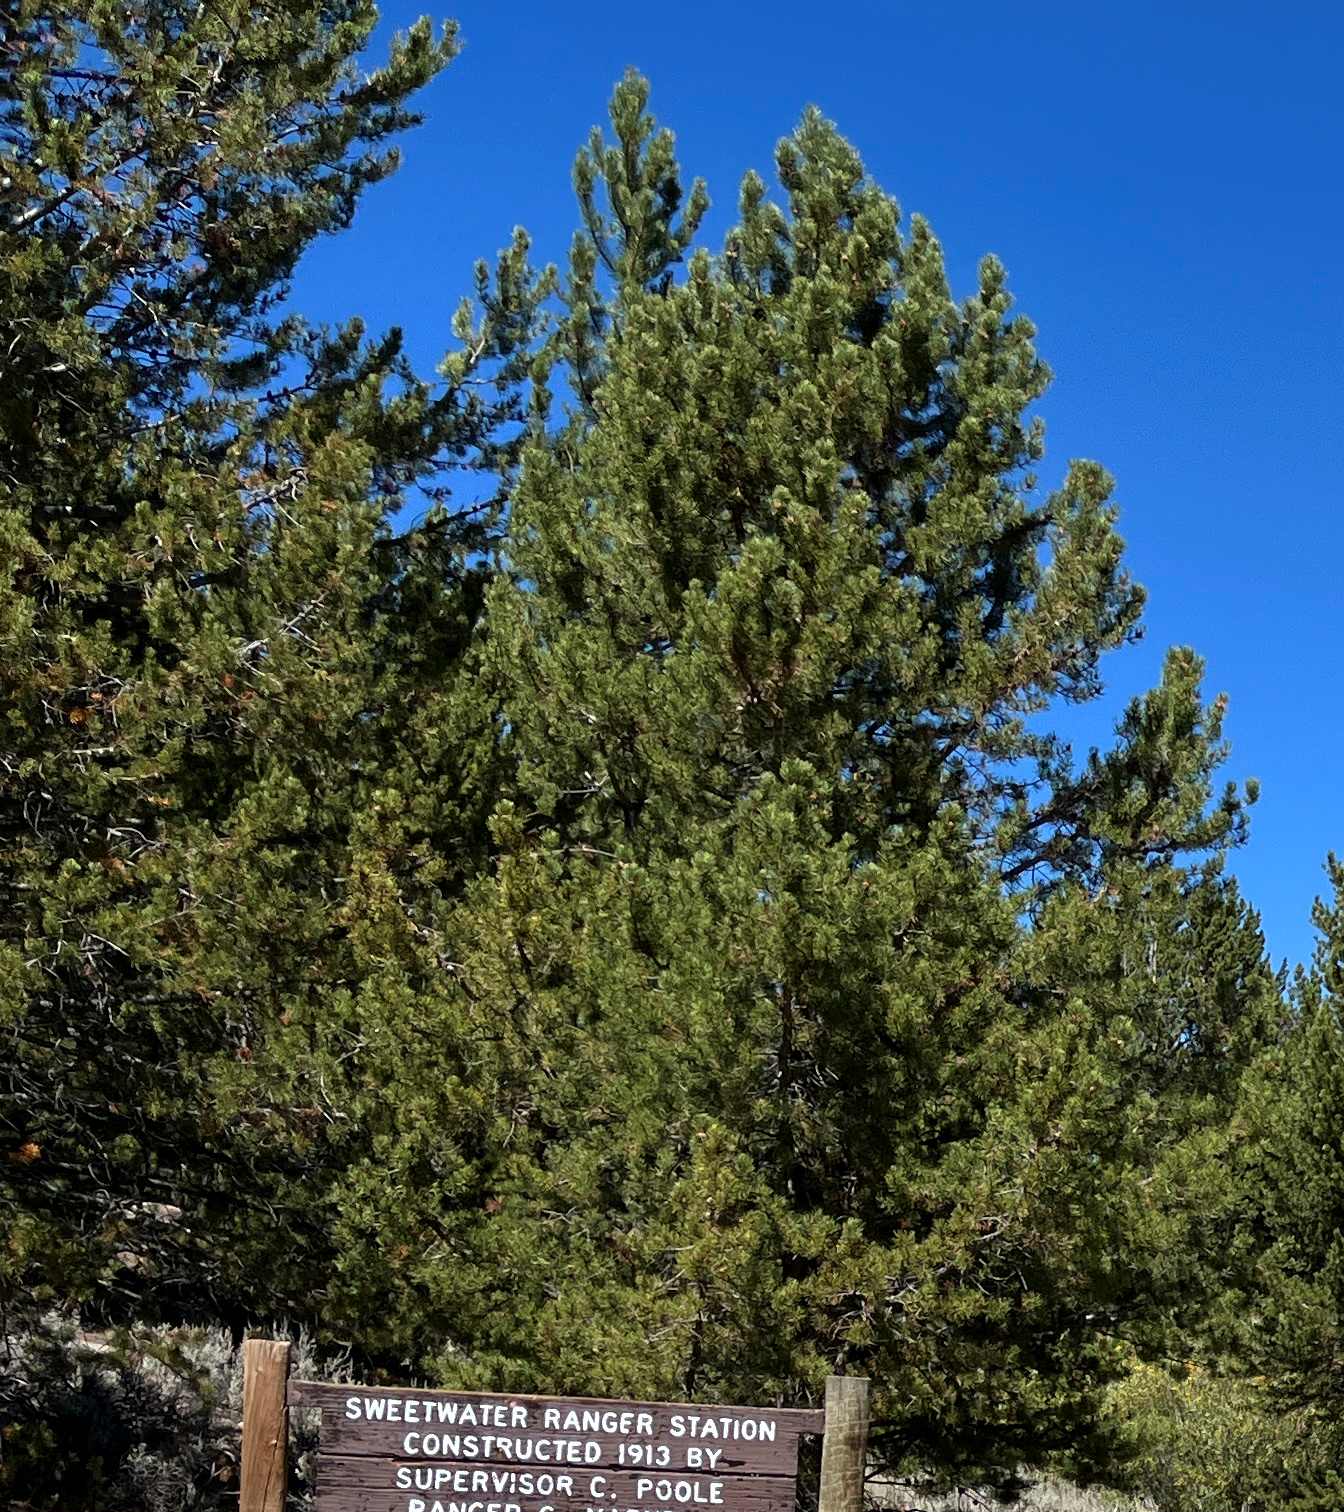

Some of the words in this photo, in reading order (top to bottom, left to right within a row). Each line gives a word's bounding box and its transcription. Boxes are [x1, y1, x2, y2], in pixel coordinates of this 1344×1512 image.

[345, 1397, 528, 1428] SWEETWATER
[544, 1408, 653, 1436] RANGER
[669, 1415, 776, 1442] STATION
[403, 1432, 601, 1464] CONSTRUCTED
[618, 1443, 671, 1467] 1913
[687, 1447, 722, 1469] BY
[396, 1468, 574, 1497] SUPERVISOR
[590, 1476, 617, 1499] C.
[637, 1478, 724, 1504] POOLE
